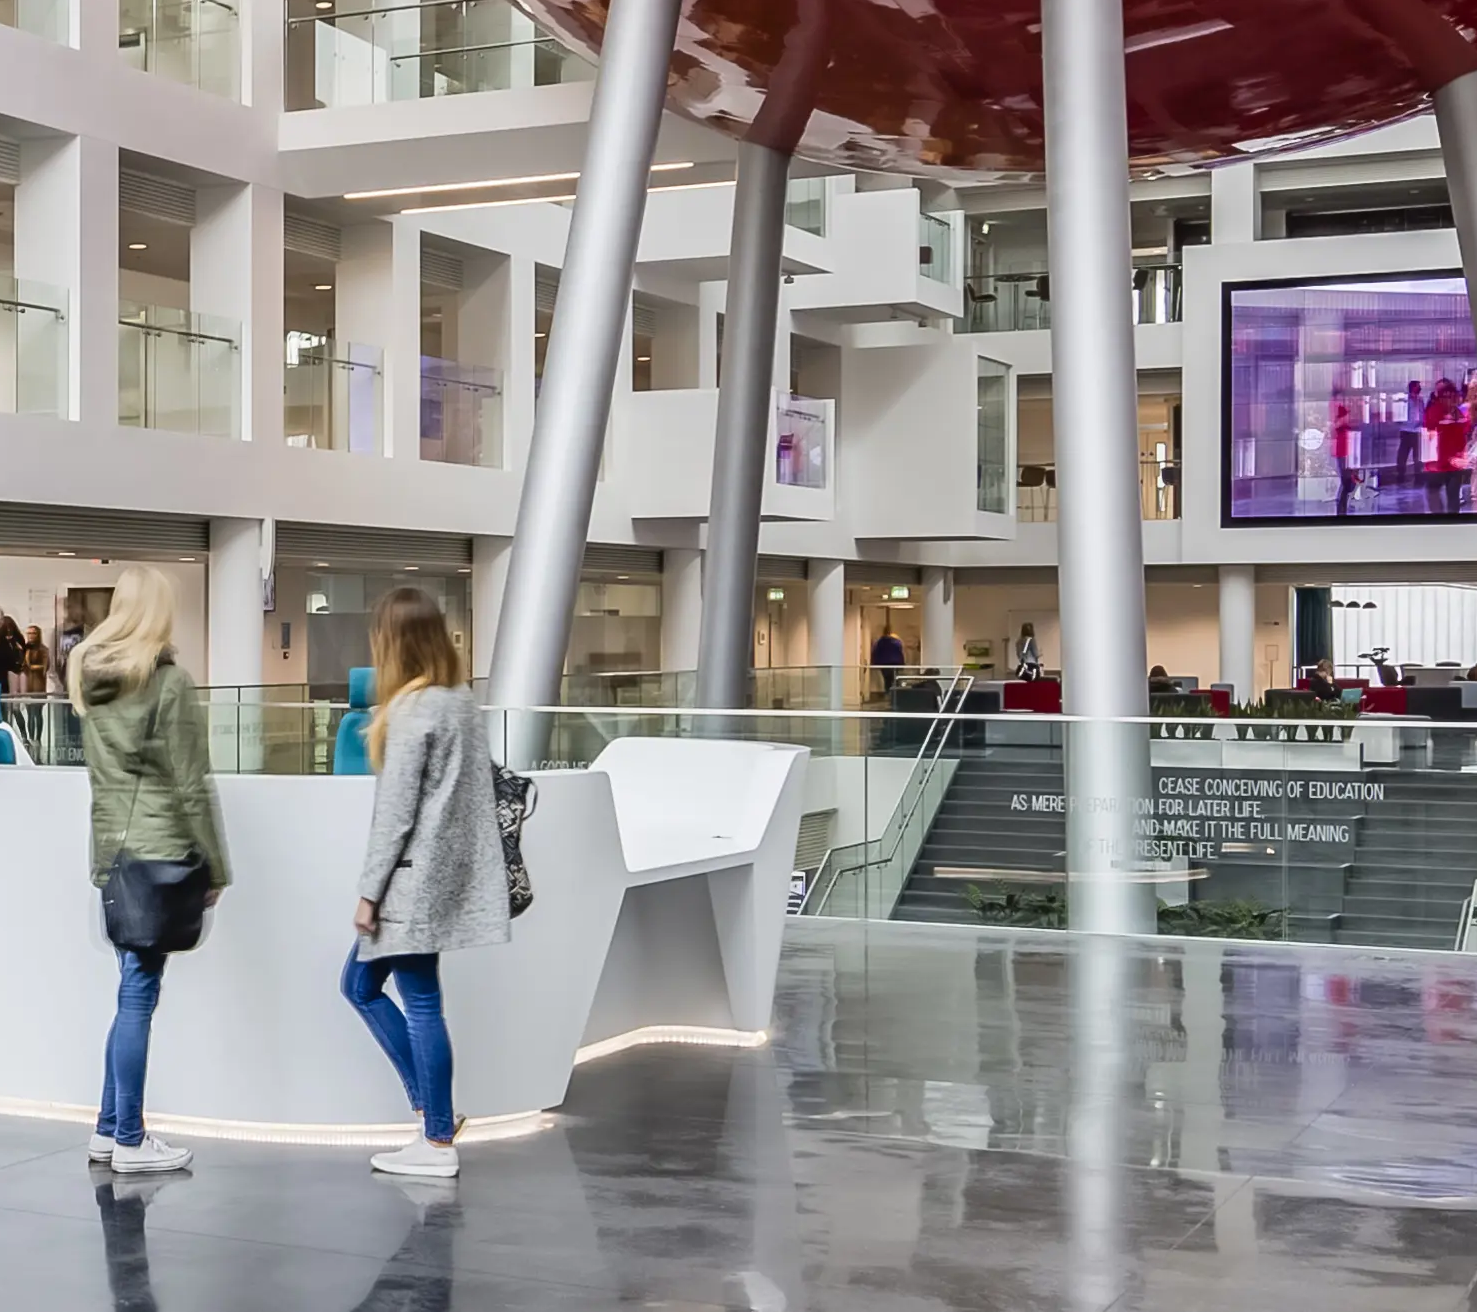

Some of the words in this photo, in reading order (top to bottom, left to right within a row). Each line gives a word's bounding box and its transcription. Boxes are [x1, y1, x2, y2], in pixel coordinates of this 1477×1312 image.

[1158, 777, 1200, 795] CEASE
[1204, 778, 1283, 798] CONCEIVING
[1287, 781, 1305, 798] OF
[1309, 781, 1385, 801] EDUCATION
[1010, 794, 1028, 812] AS
[1032, 795, 1066, 813] MERE
[1158, 799, 1184, 816] FOR
[1188, 800, 1230, 817] LATER
[1132, 819, 1159, 836] AND
[1163, 819, 1200, 837] MAKE
[1204, 820, 1219, 838] IT
[1220, 821, 1246, 839] THE
[1249, 822, 1283, 840] FULL
[1287, 824, 1350, 843] MEANING
[1132, 839, 1186, 858] RESENT
[1189, 841, 1218, 860] LIFE.
